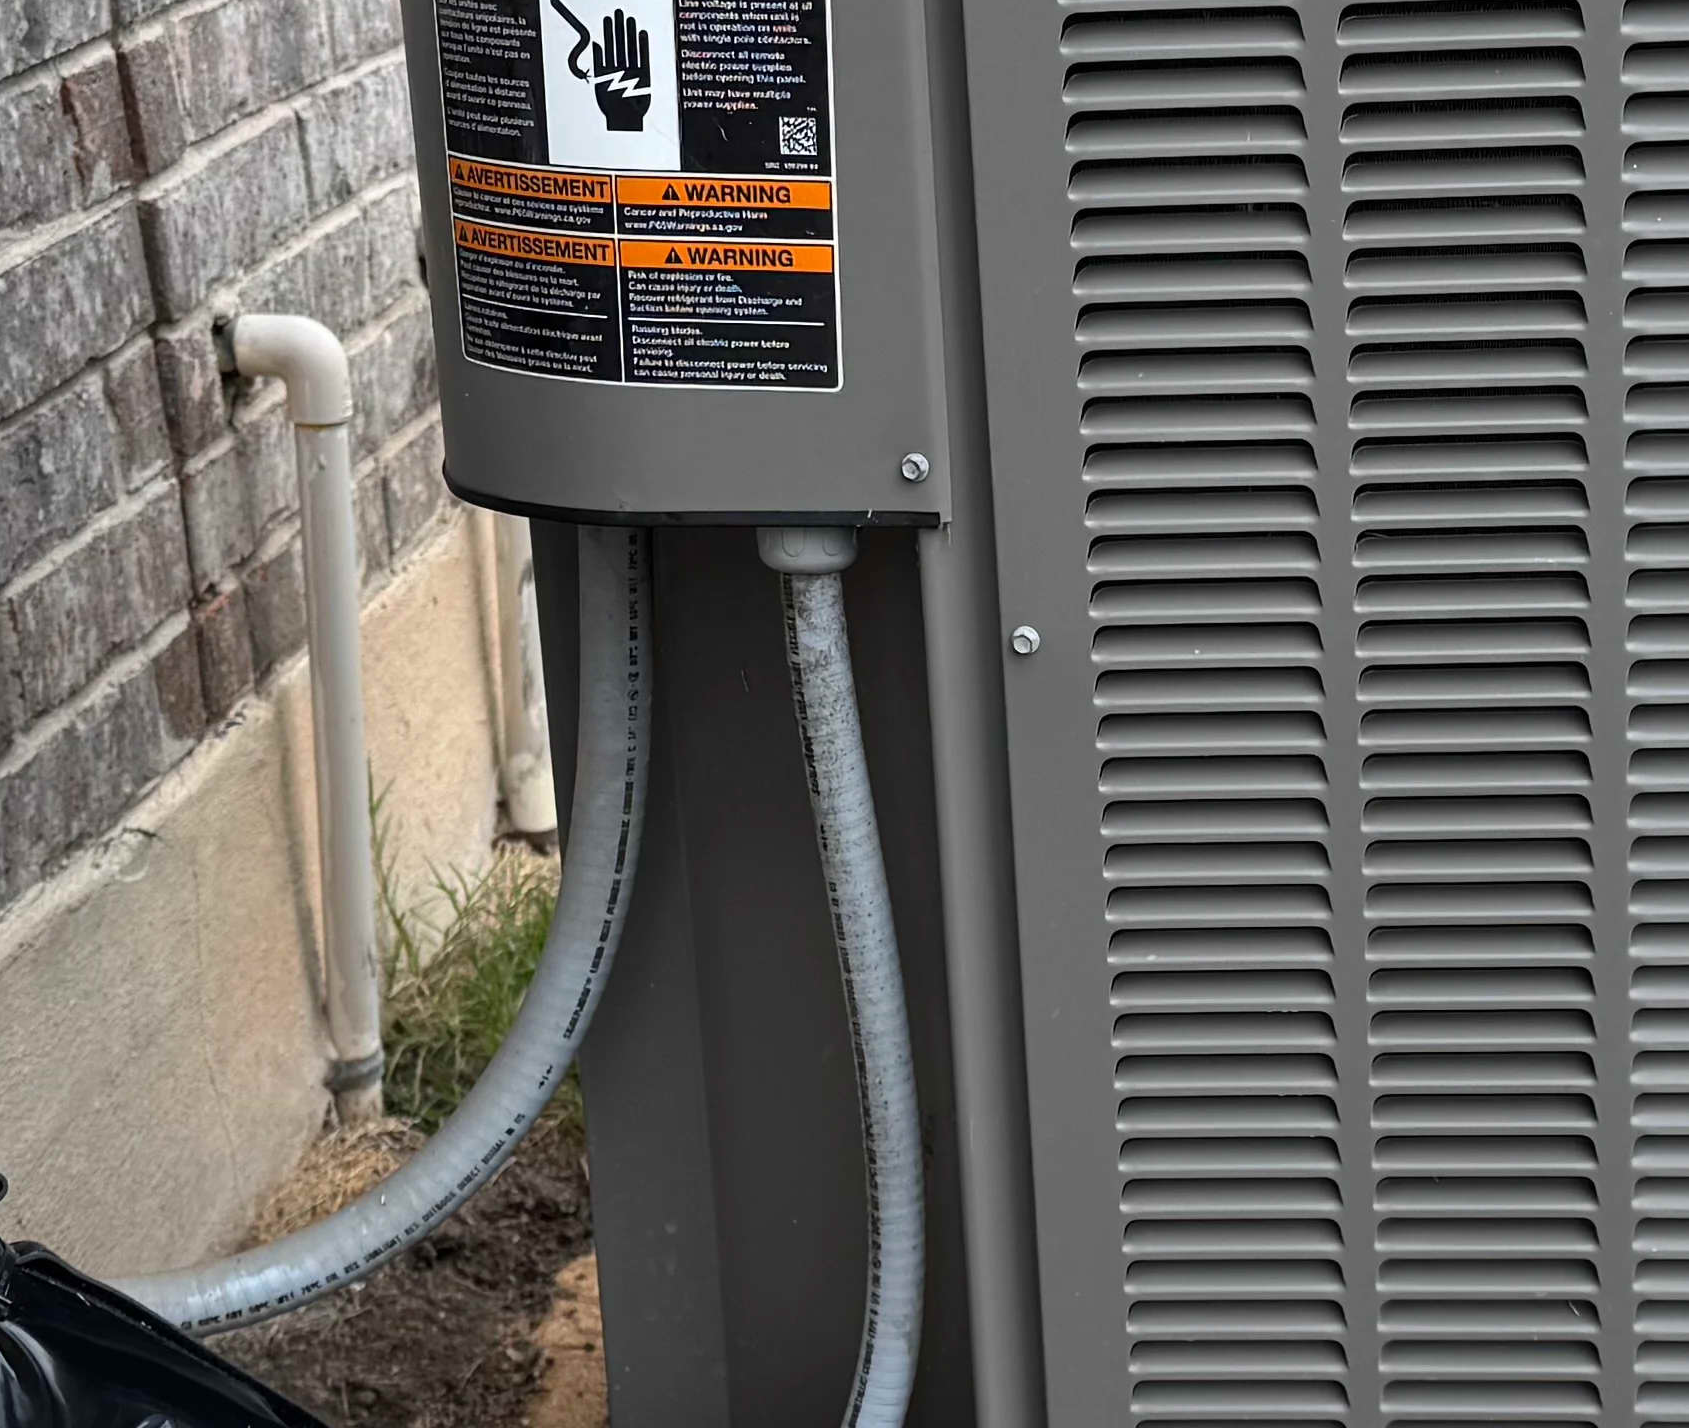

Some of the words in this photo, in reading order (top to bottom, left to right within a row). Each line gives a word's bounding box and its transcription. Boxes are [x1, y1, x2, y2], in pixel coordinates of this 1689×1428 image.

[468, 166, 608, 198] AVERTISSEMENT
[684, 184, 791, 203] WARNING
[471, 228, 609, 261] AVERTISSEMENT
[687, 247, 793, 267] WARNING
